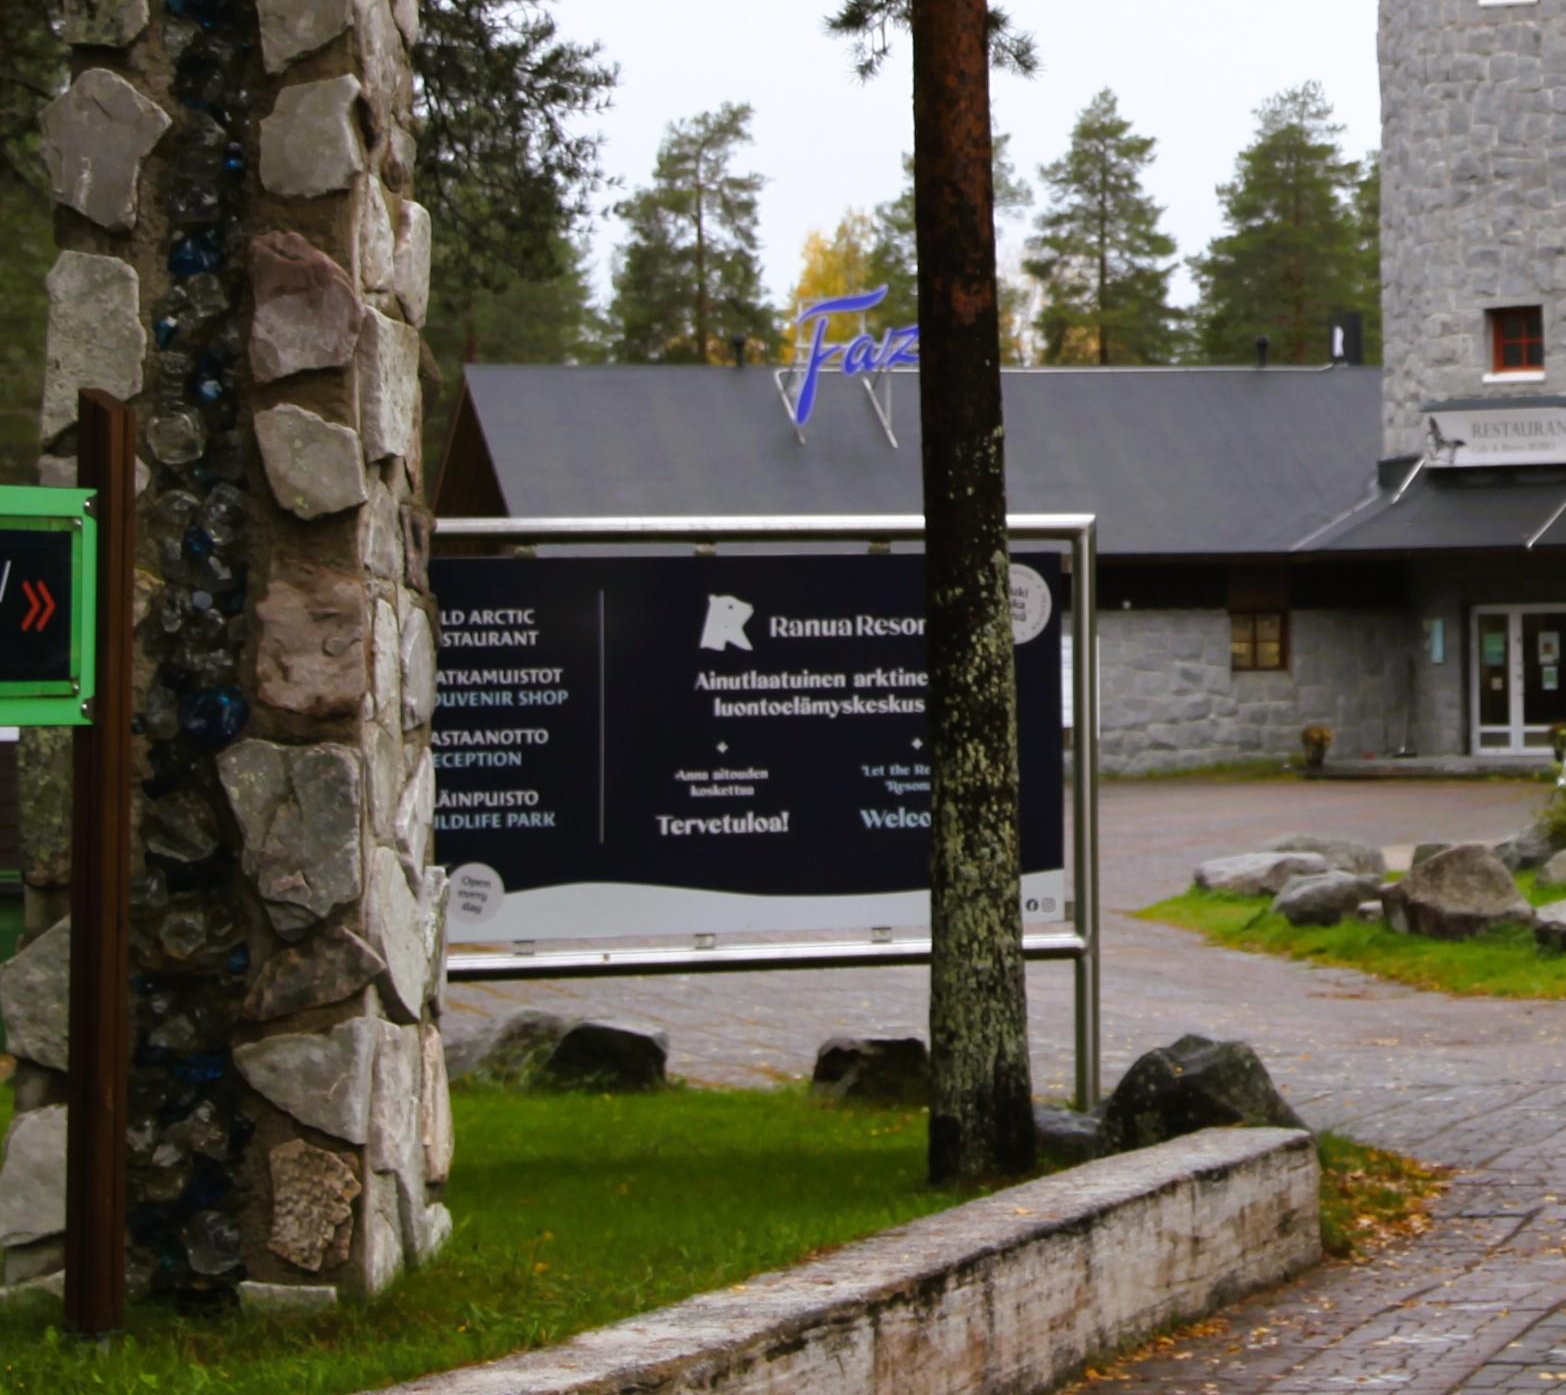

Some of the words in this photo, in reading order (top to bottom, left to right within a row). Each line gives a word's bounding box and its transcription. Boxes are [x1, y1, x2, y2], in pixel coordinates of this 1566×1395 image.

[469, 609, 535, 625] ARCTIC
[770, 615, 852, 638] Ranua
[856, 614, 927, 637] Resor
[442, 630, 539, 647] STAURANT
[435, 668, 563, 685] ATKAMUISTOT
[695, 670, 846, 691] Ainutlaatuinen
[854, 667, 929, 687] arktine
[436, 691, 515, 707] OUVENIR
[519, 689, 569, 705] SHOP
[714, 694, 926, 719] luontoelämyskeskus
[432, 728, 549, 746] ASTAANOTTO
[433, 751, 523, 768] ECEPTION
[890, 763, 911, 776] the
[436, 791, 539, 808] ÄINPUISTO
[434, 813, 501, 830] ILDLIFE
[507, 811, 556, 828] PARK
[656, 810, 790, 836] Tervetuloa!
[859, 806, 932, 829] Welco
